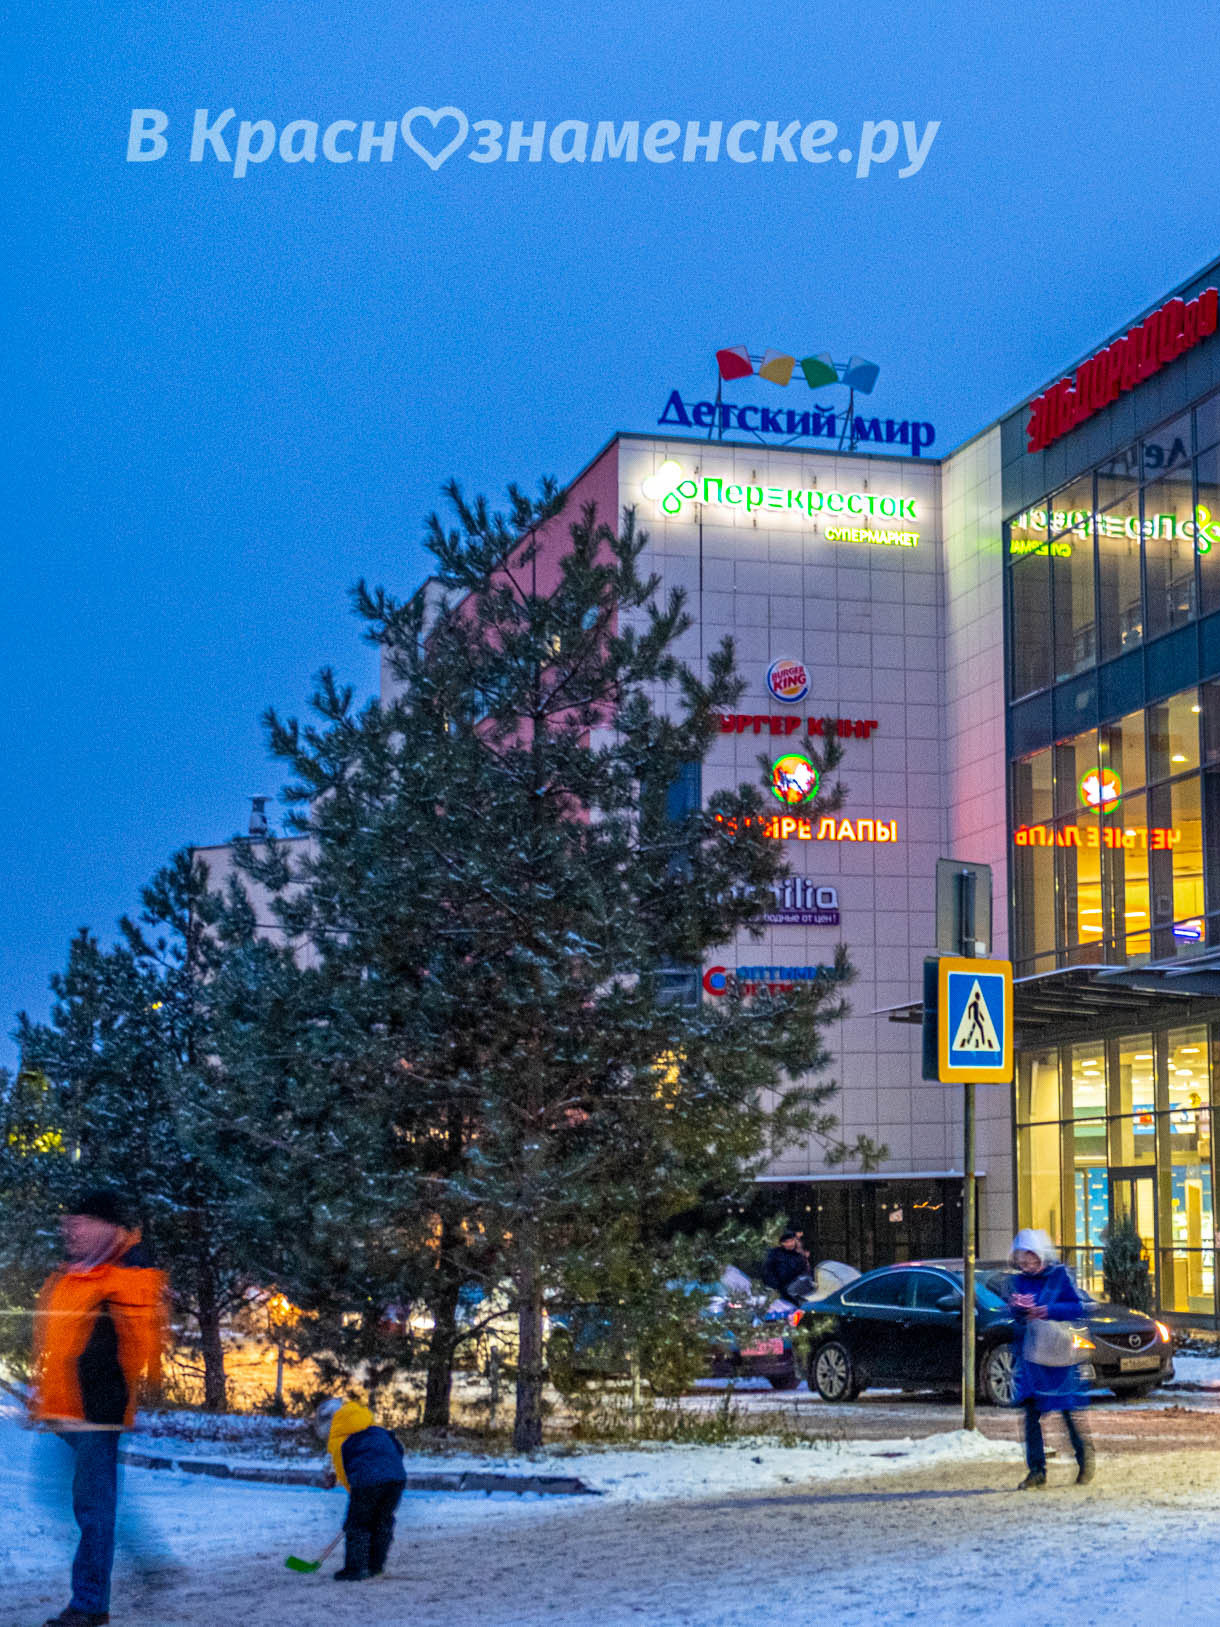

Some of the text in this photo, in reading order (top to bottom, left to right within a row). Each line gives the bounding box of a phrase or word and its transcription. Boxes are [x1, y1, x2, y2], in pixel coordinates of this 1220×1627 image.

[657, 389, 936, 457] Детский мир
[824, 526, 920, 548] СУПЕРМАРКЕТ
[771, 666, 805, 681] BURGER
[773, 675, 807, 692] KING
[716, 714, 802, 736] УРГЕР
[816, 817, 898, 843] ЛАПЫ
